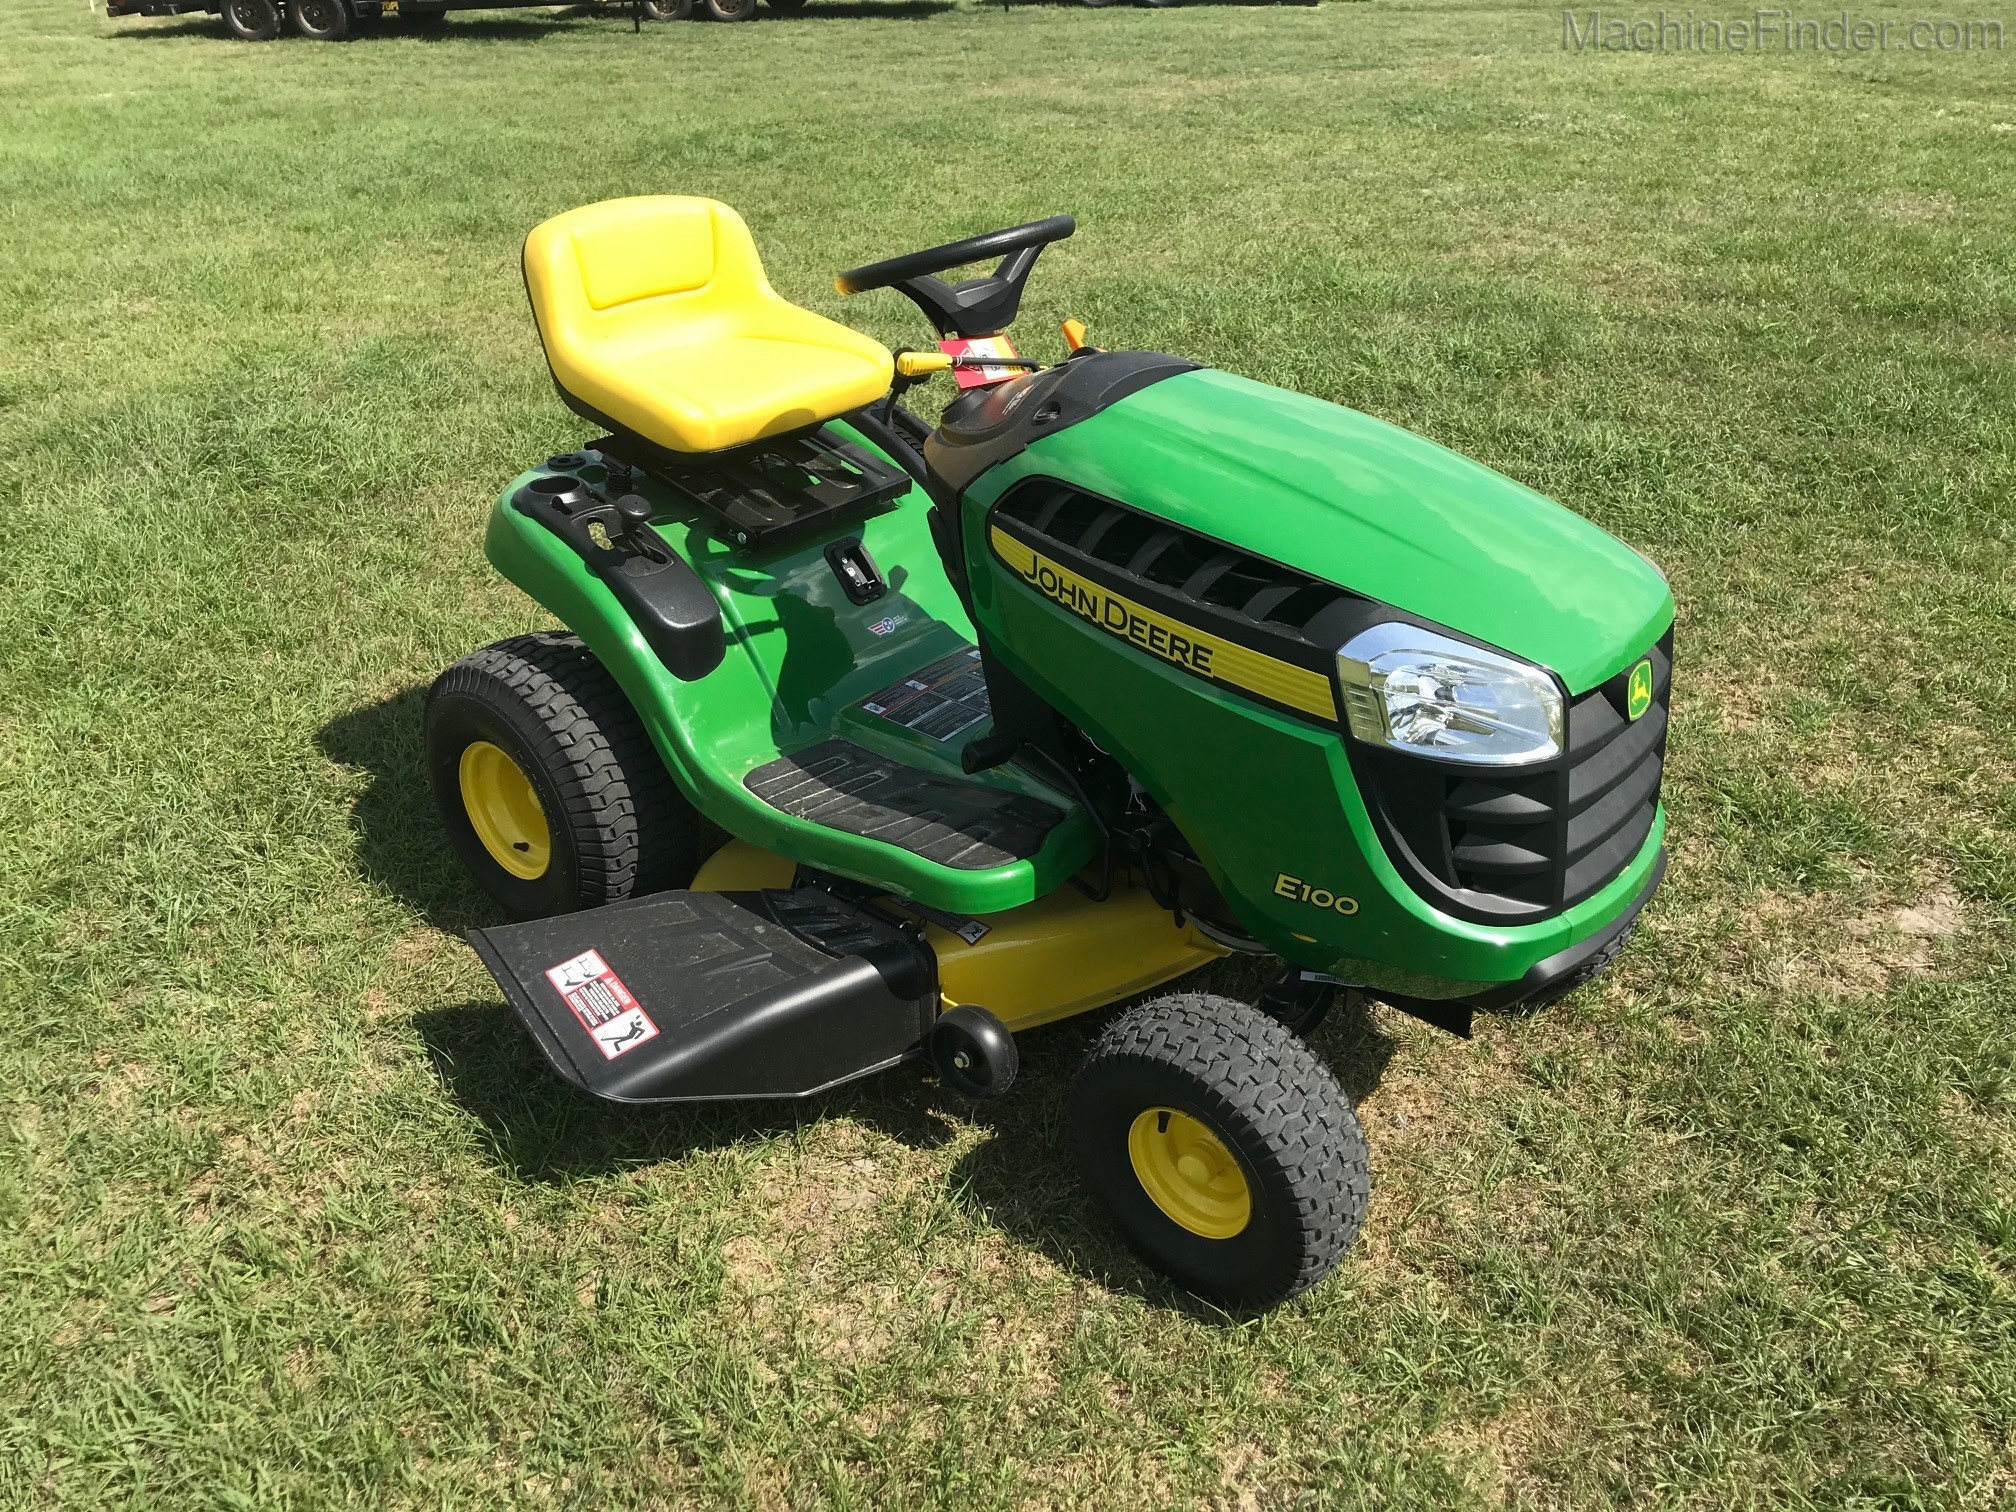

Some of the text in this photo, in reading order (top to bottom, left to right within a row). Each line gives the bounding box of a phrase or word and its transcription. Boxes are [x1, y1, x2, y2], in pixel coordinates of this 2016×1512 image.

[1023, 554, 1214, 674] JOHN DEERE
[1274, 873, 1359, 915] E100
[609, 980, 632, 1006] DANGER
